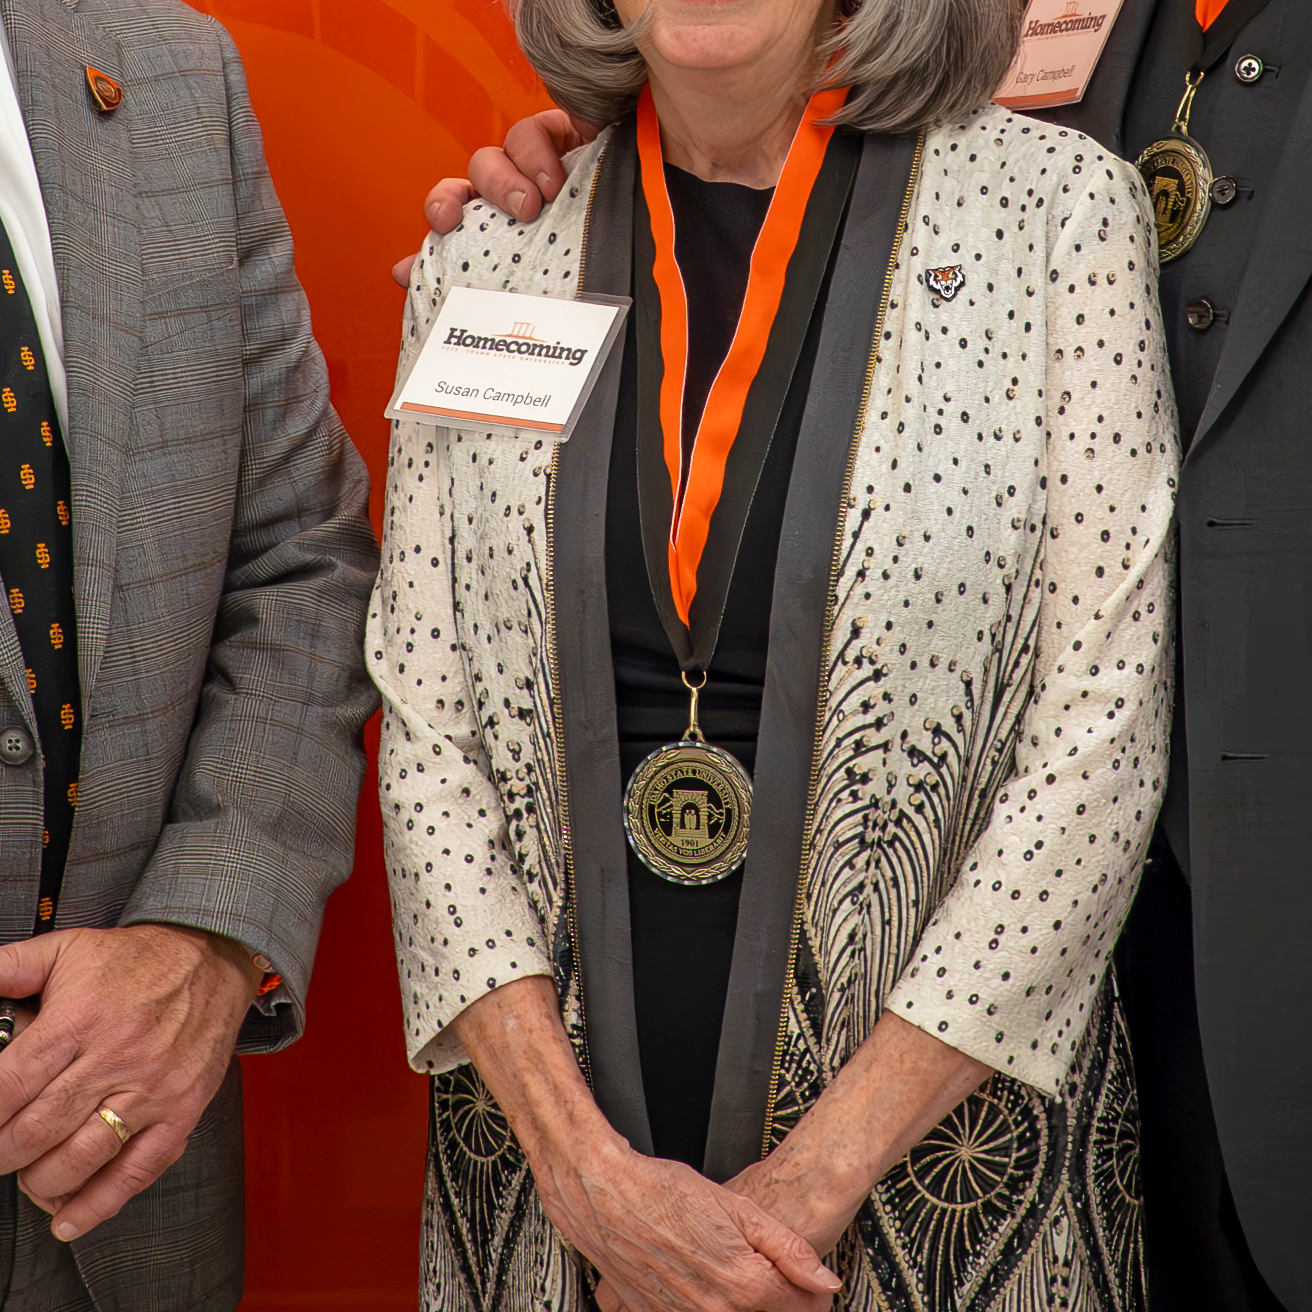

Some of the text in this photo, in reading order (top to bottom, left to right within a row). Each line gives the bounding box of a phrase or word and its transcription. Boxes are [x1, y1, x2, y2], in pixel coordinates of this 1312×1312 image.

[1023, 11, 1107, 38] Homecoming
[442, 326, 588, 367] Homecoming
[434, 380, 551, 408] Susan Campbell
